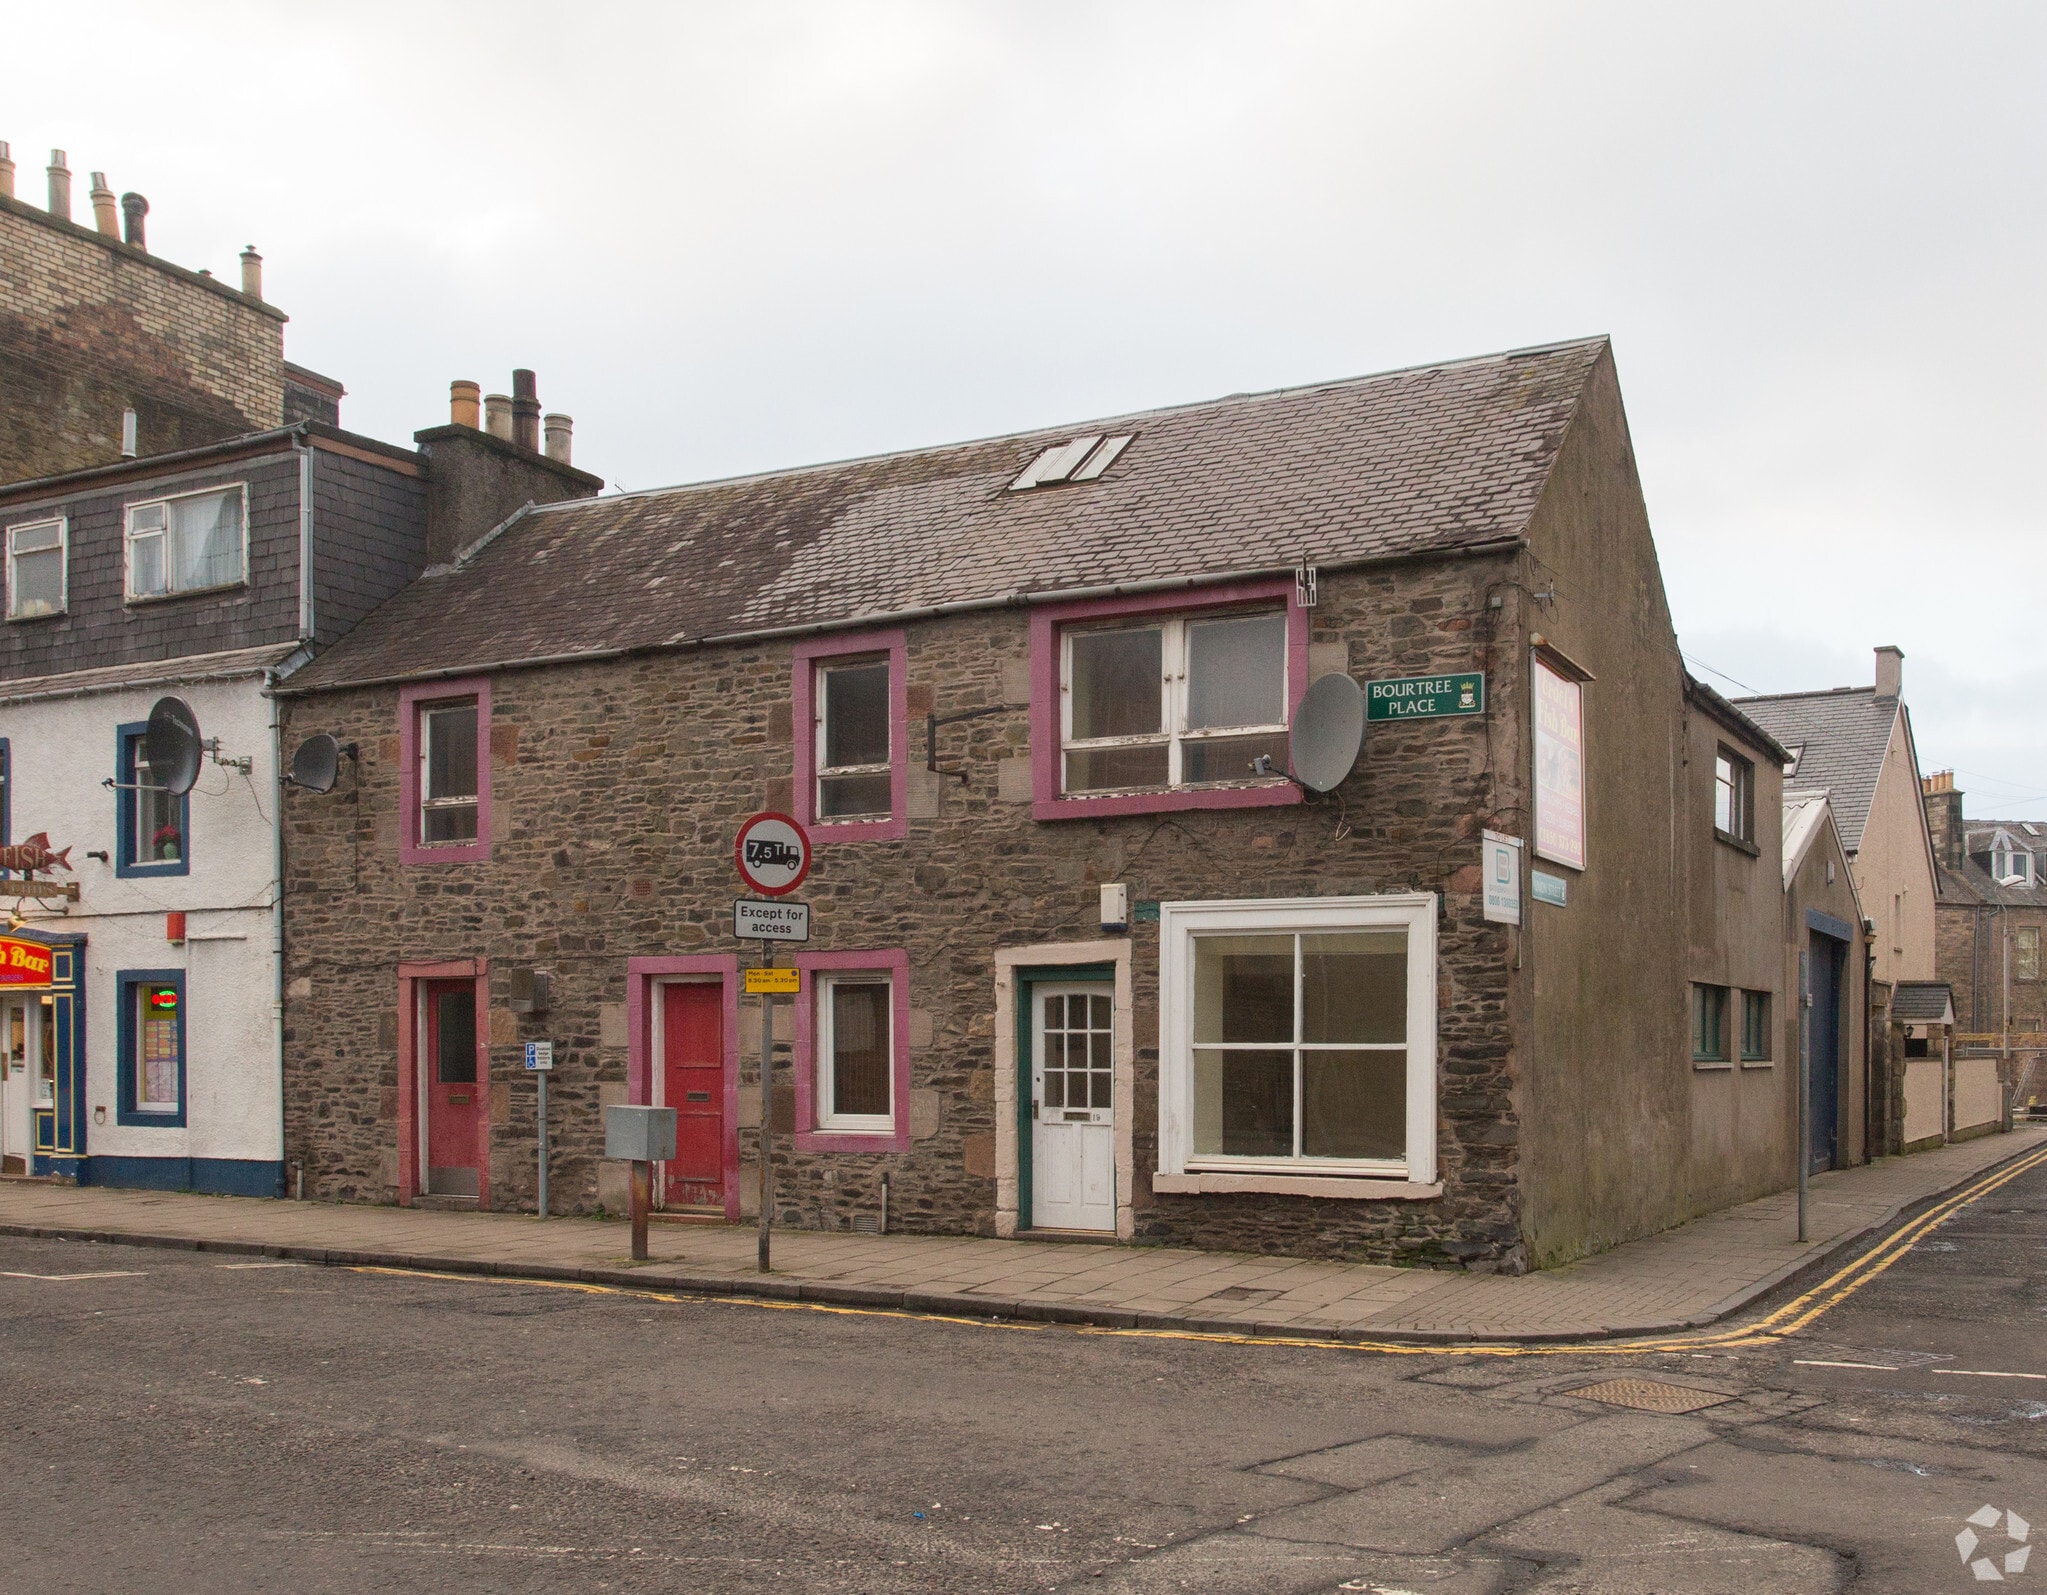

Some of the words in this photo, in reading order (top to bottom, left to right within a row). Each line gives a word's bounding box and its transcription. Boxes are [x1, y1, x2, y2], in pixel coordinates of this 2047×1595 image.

[1373, 680, 1452, 698] BOURTREE
[1388, 699, 1436, 715] PLACE
[3, 846, 46, 869] FISH
[741, 906, 782, 920] Except
[786, 909, 803, 920] for
[752, 923, 792, 934] access
[10, 946, 49, 973] Bar
[529, 1045, 534, 1055] P
